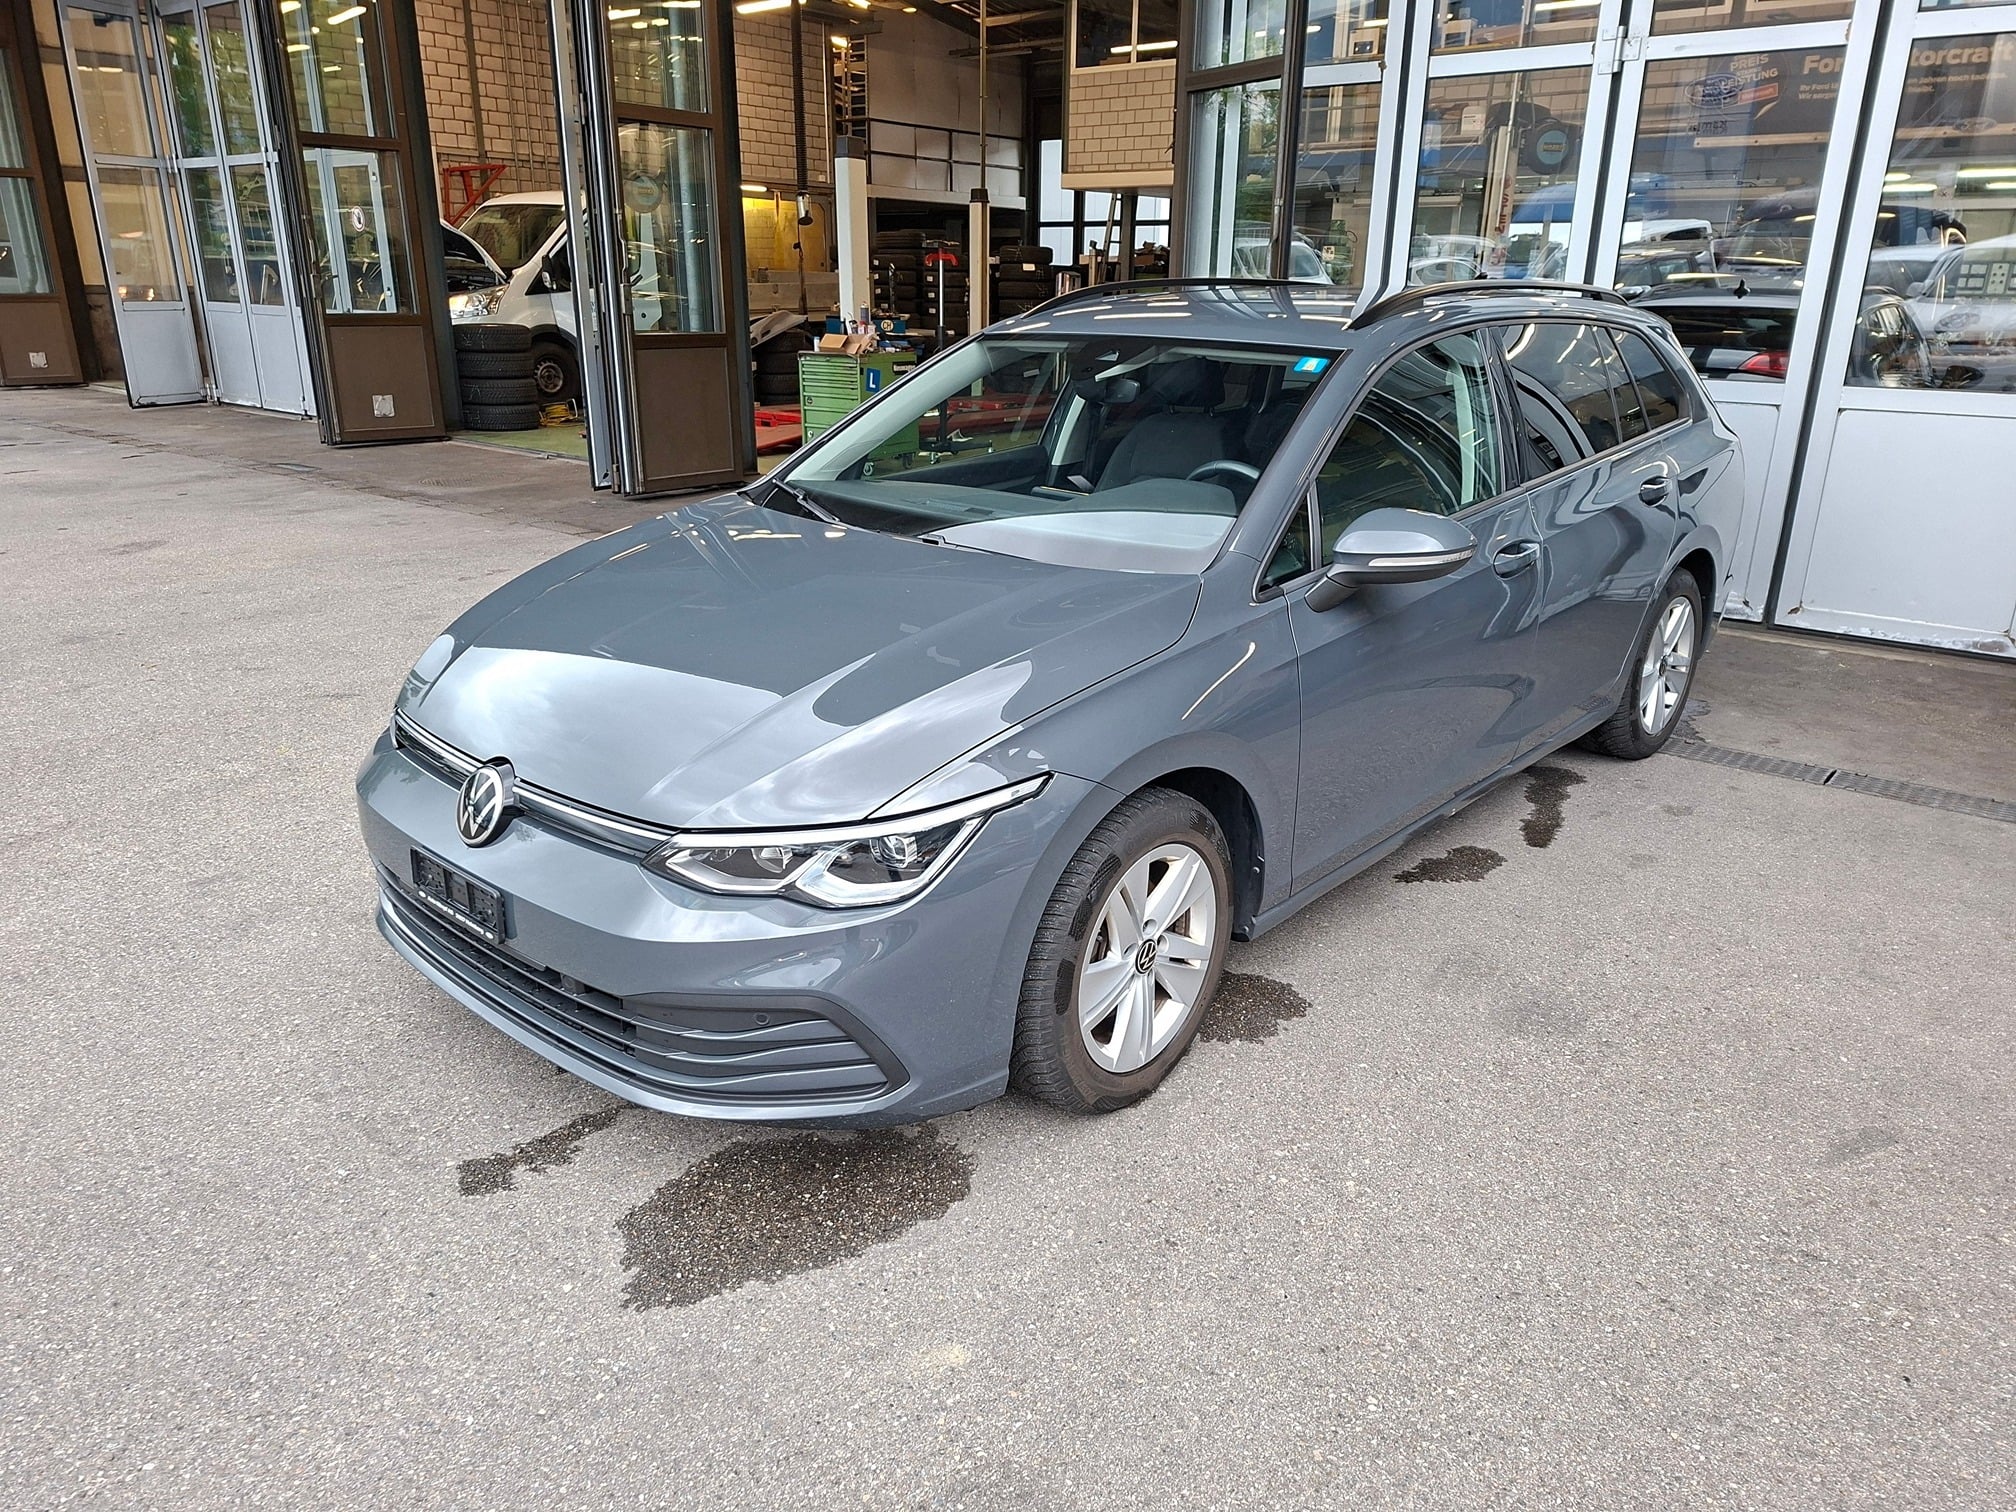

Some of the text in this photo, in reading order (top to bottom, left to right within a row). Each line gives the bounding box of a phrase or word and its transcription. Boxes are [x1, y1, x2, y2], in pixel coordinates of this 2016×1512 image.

[1730, 54, 1769, 71] PREIS
[882, 321, 892, 330] CH
[869, 372, 876, 388] L
